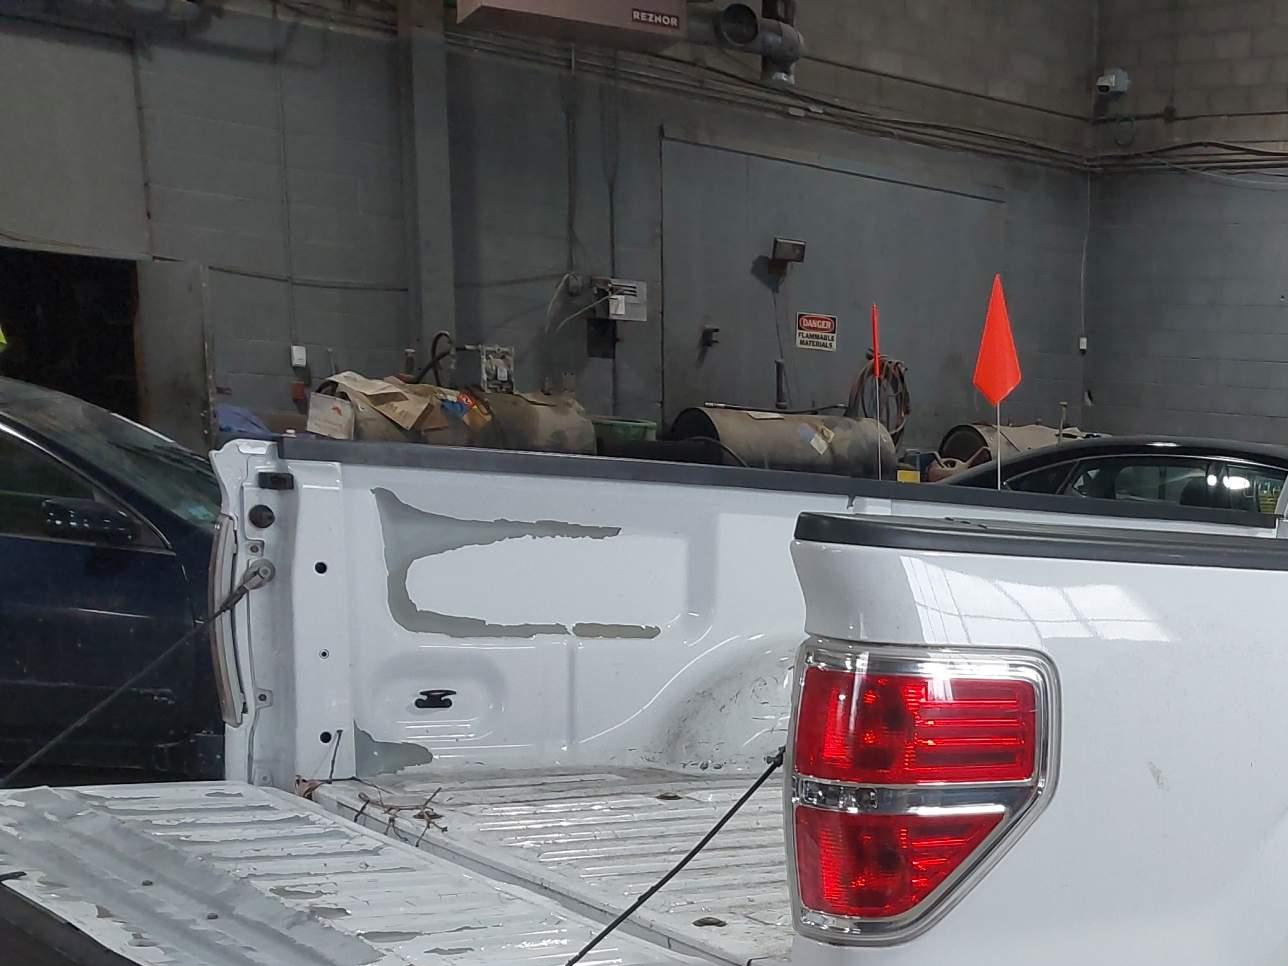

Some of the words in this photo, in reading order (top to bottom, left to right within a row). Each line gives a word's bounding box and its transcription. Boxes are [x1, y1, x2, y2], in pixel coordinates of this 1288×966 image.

[633, 10, 678, 27] REZNOR
[802, 318, 832, 329] DANGER
[798, 331, 835, 342] FLAMMABLE
[799, 339, 833, 349] MATERIALS
